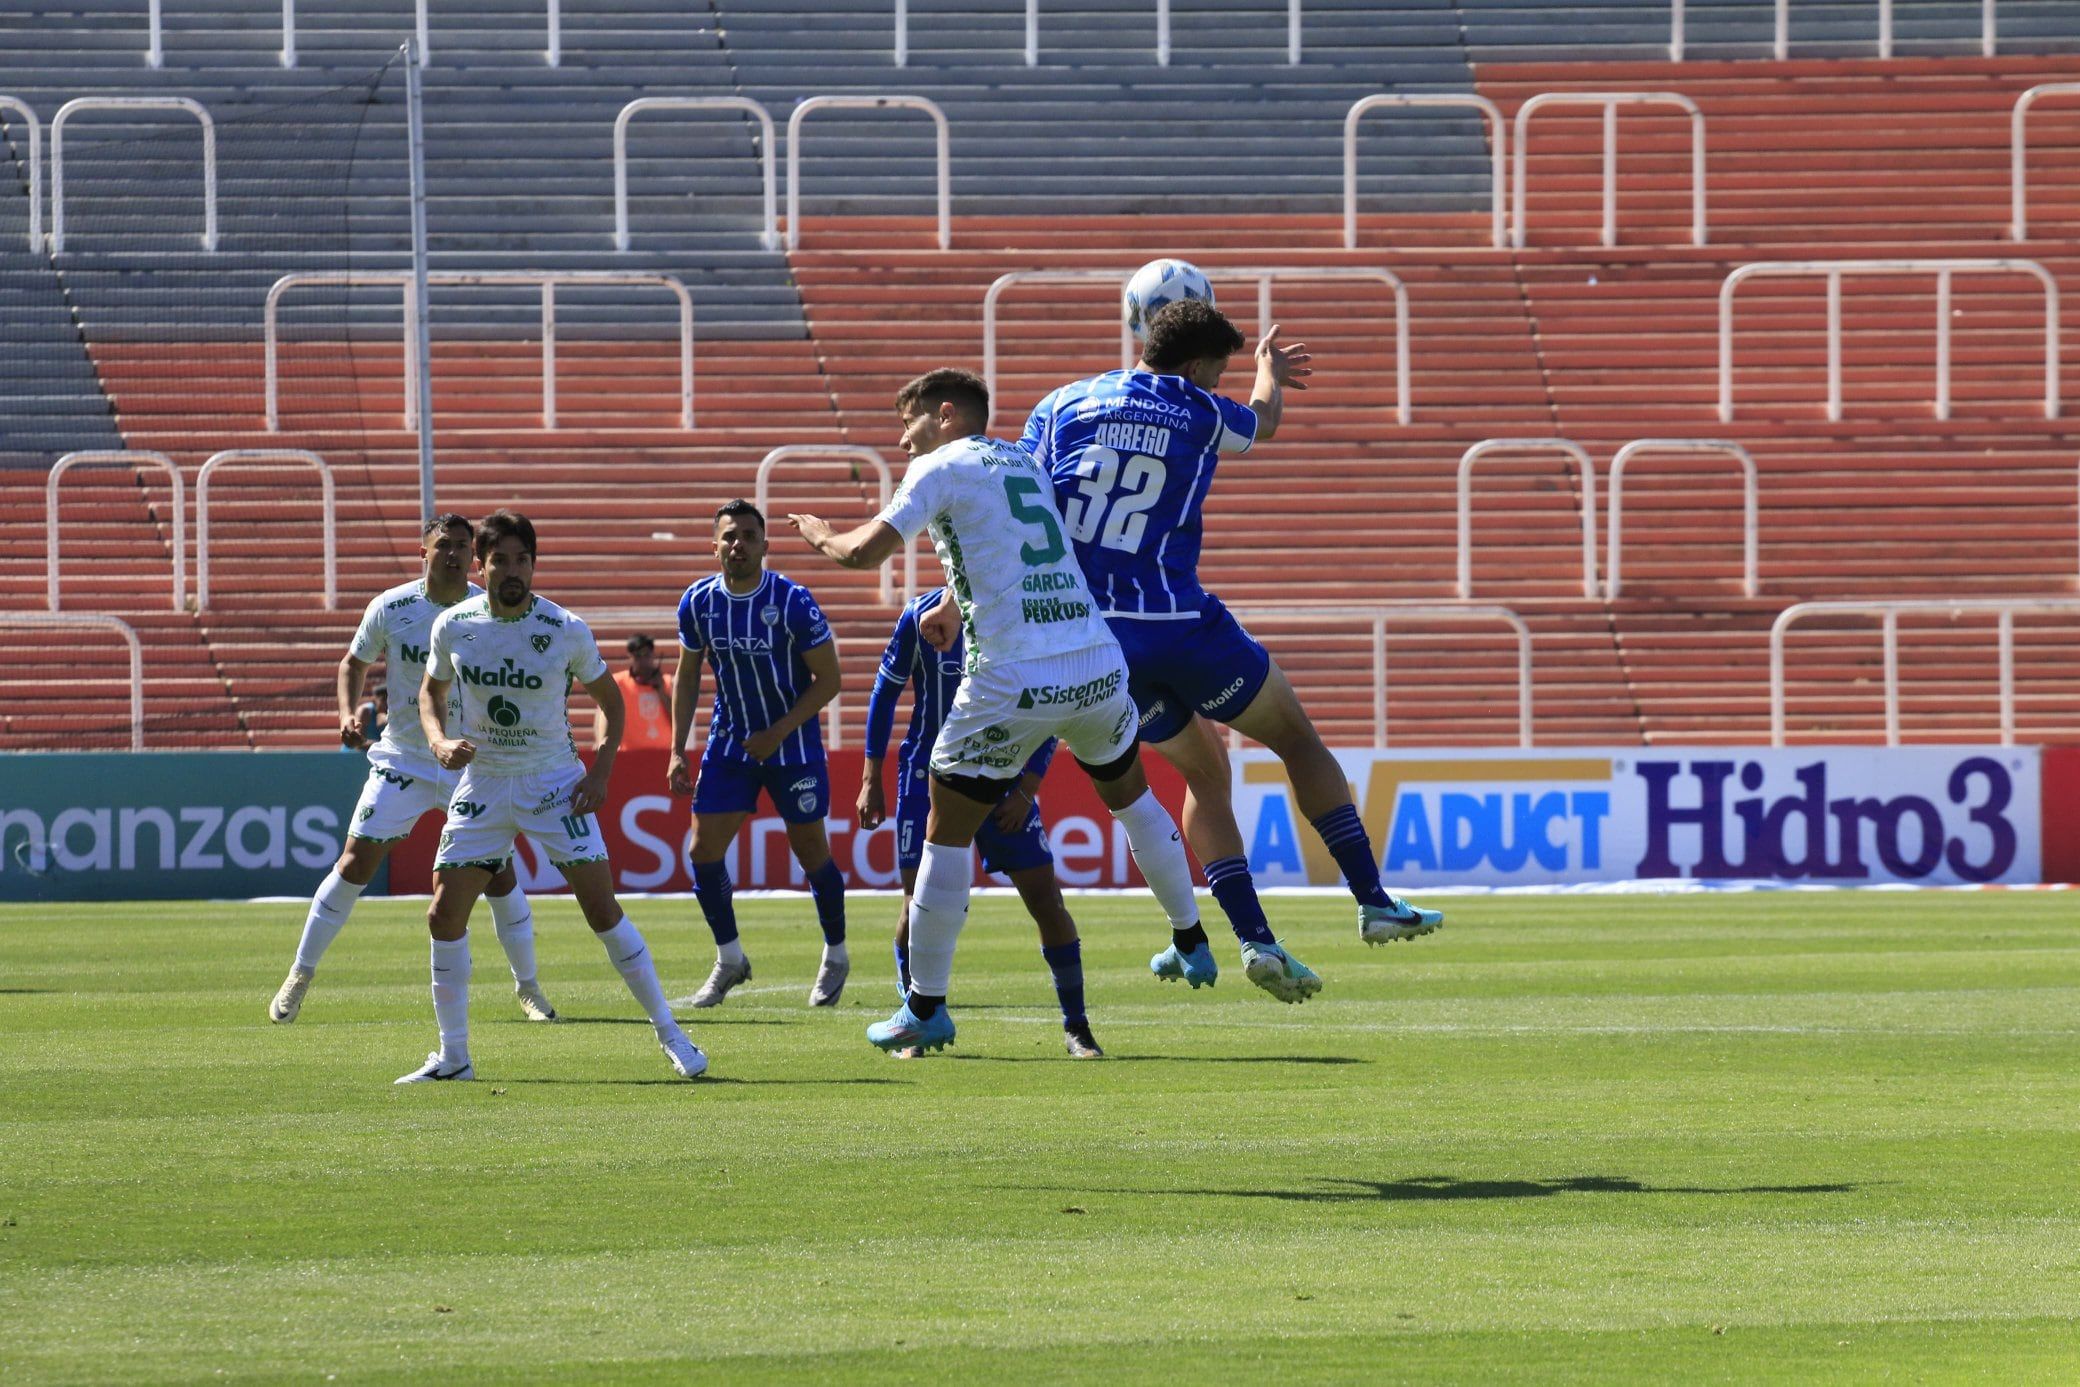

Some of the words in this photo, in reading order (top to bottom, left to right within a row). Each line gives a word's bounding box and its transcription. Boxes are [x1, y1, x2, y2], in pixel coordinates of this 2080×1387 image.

[1104, 410, 1190, 432] ARGENTINA
[1105, 396, 1192, 420] MENDOZA
[1094, 422, 1171, 458] ARREGO
[1065, 445, 1167, 554] 32
[1003, 475, 1067, 567] 5
[1022, 572, 1080, 592] GARCIA
[388, 595, 418, 610] FMC
[535, 614, 563, 628] FMC
[710, 637, 772, 651] CATA
[461, 660, 543, 690] Naldo
[1038, 669, 1121, 704] Sistemas
[1201, 676, 1245, 711] Molico
[488, 736, 528, 747] FAMILIA
[489, 727, 538, 738] PEQUEÑA
[560, 815, 591, 840] 10
[1636, 756, 2017, 882] Hidro3
[0, 805, 340, 872] nanzas
[901, 820, 914, 853] 5
